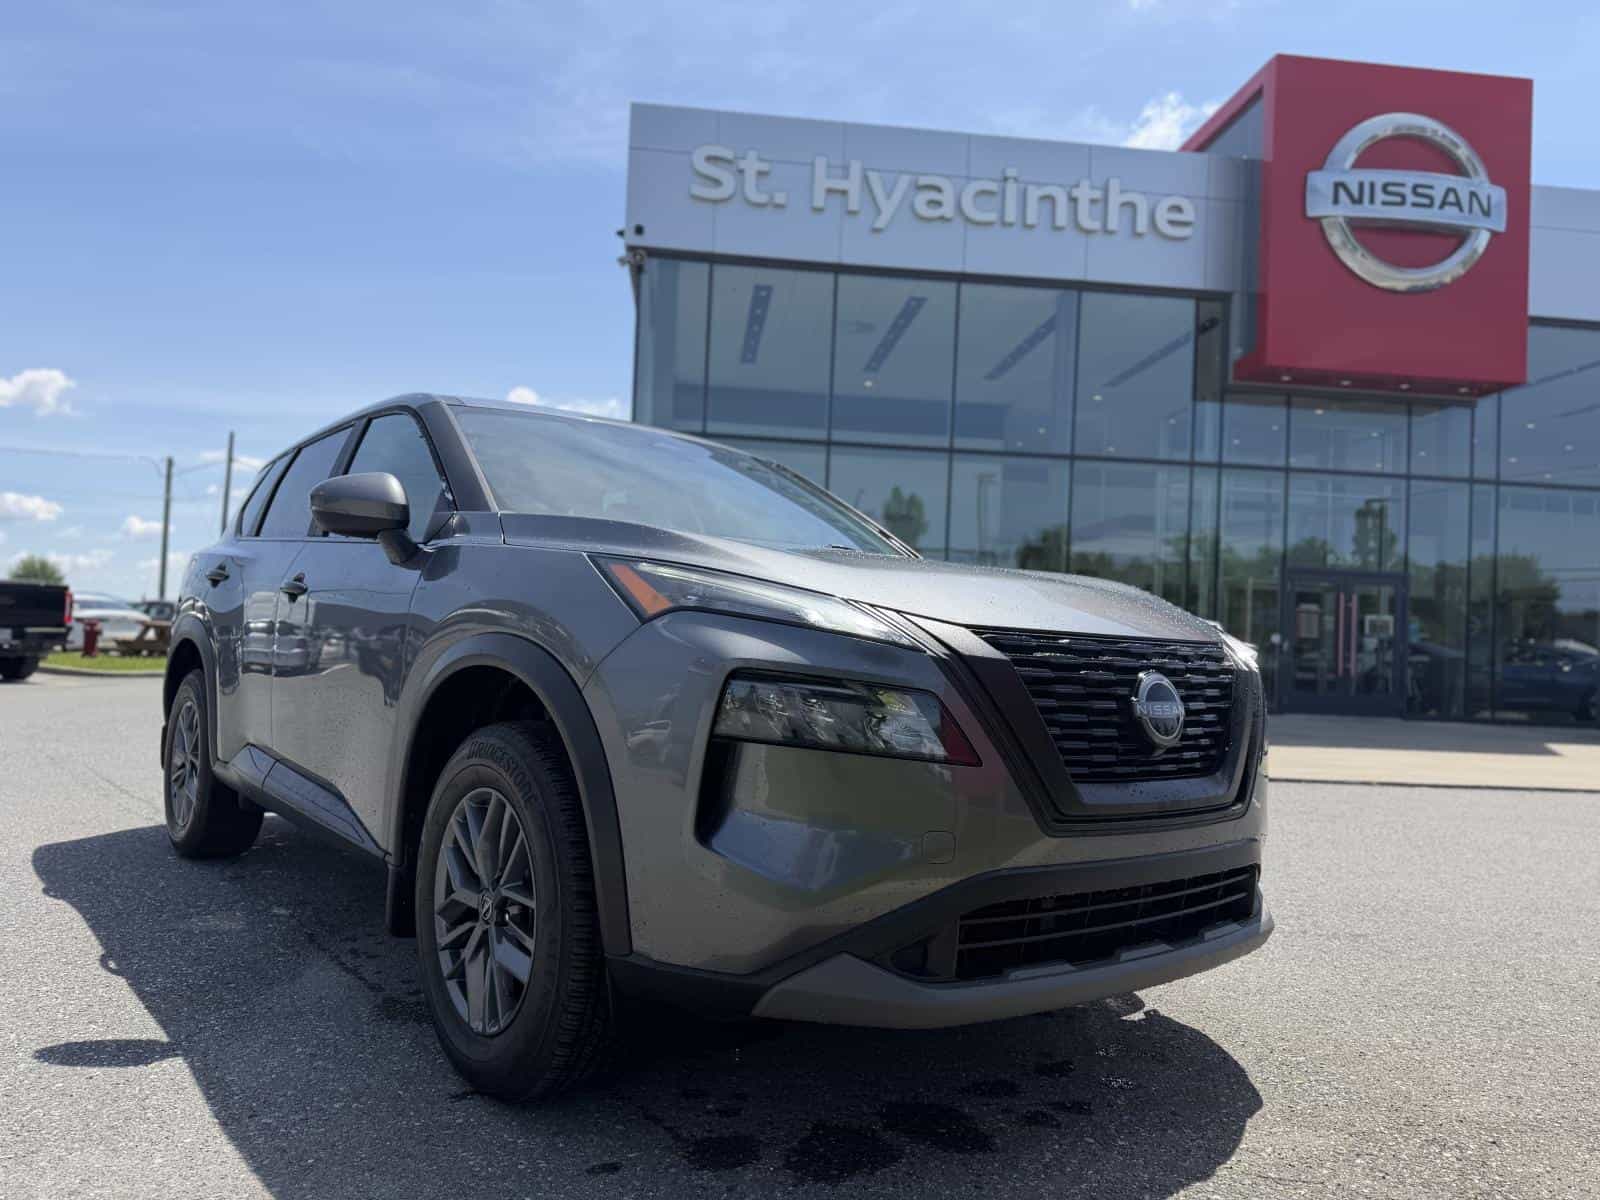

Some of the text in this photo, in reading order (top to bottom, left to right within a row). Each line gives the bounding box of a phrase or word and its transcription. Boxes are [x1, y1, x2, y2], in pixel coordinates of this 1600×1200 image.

[690, 145, 1196, 239] St. Hyacinthe
[1332, 181, 1493, 218] NISSAN
[1136, 702, 1184, 716] NISSAN
